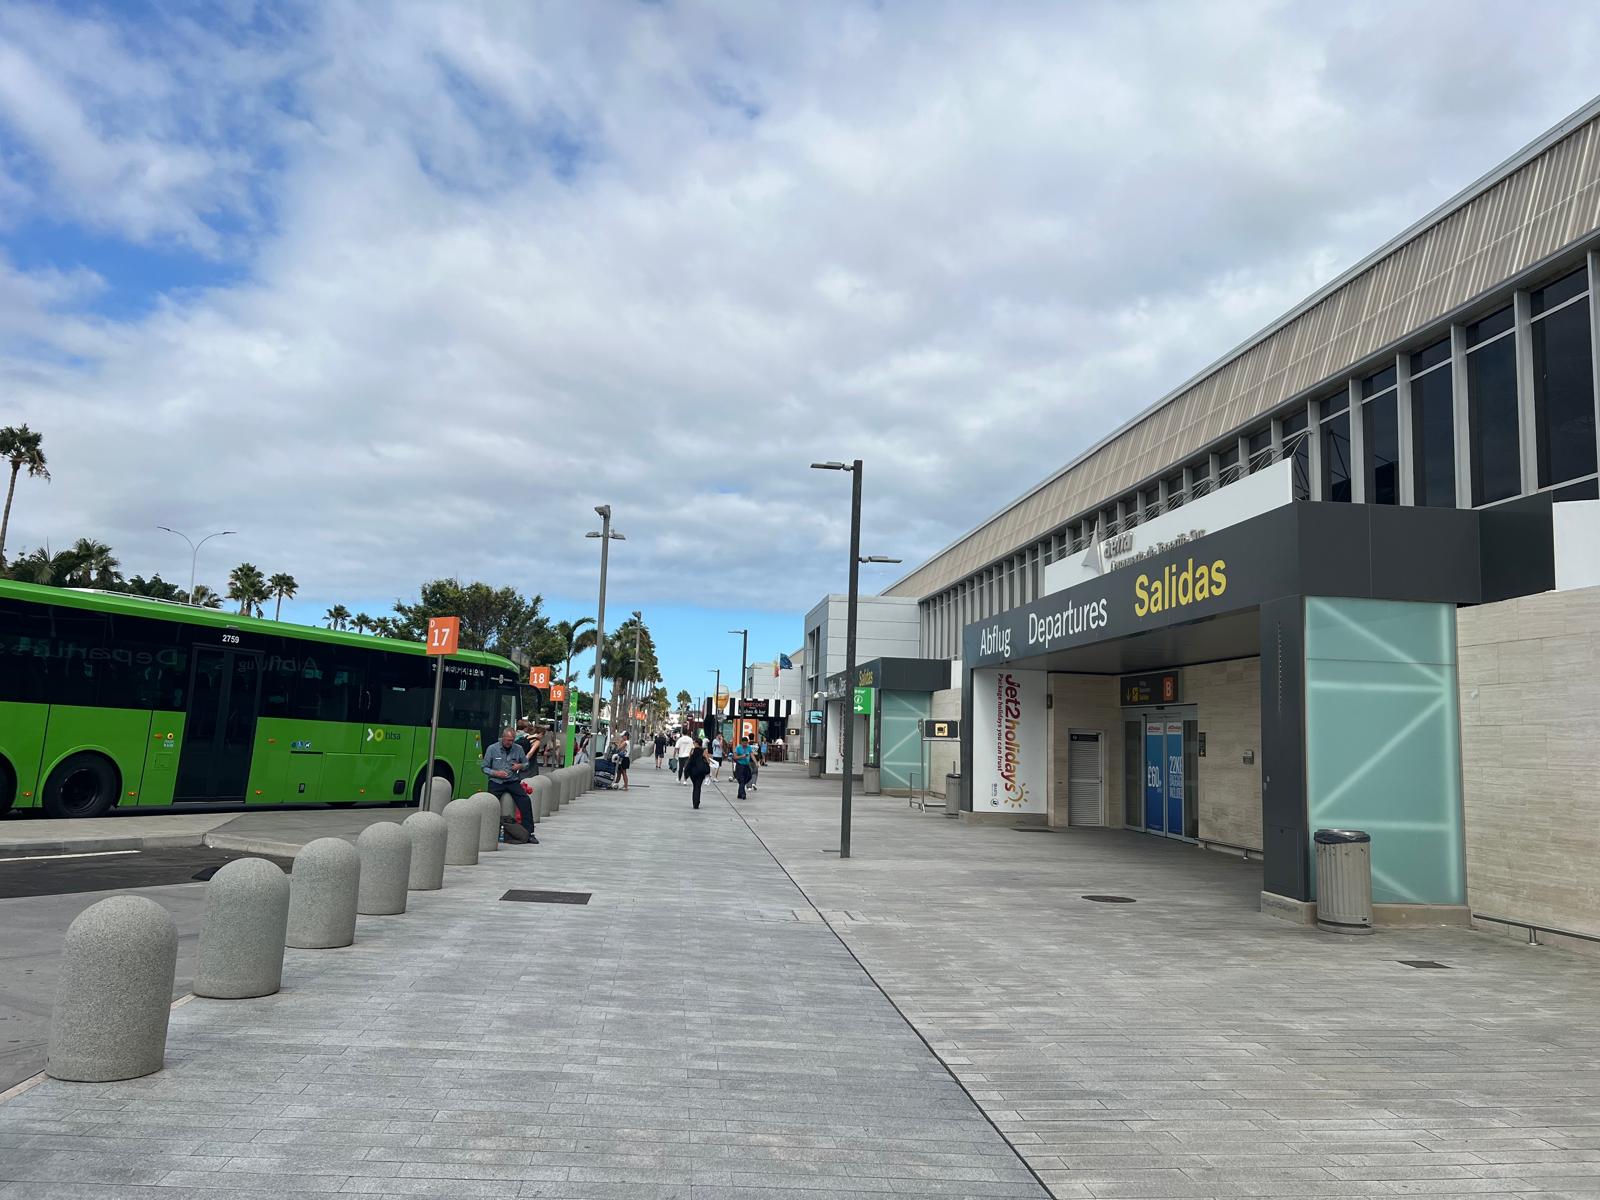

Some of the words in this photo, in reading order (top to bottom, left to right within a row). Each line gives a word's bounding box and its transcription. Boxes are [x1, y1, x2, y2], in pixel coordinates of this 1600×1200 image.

[1134, 558, 1227, 617] Salidas
[430, 619, 436, 628] D
[1028, 598, 1108, 648] Departures
[222, 634, 240, 644] 2759
[432, 628, 450, 647] 17
[979, 625, 1011, 658] Abflug
[532, 672, 545, 684] 18
[552, 690, 562, 698] 19
[1165, 681, 1172, 697] B
[996, 701, 1004, 728] holidays
[1001, 672, 1021, 793] Jet2holidays
